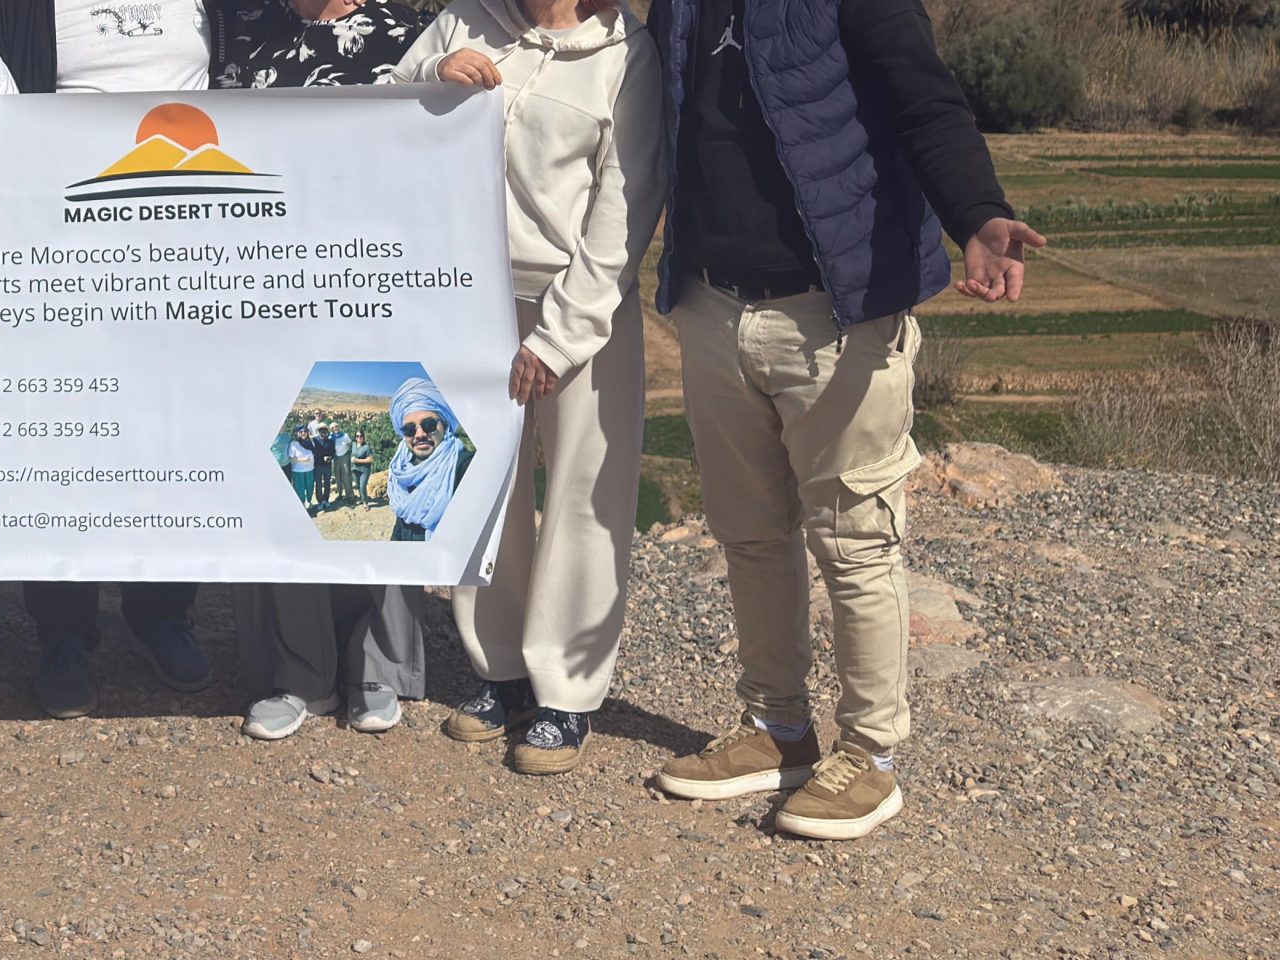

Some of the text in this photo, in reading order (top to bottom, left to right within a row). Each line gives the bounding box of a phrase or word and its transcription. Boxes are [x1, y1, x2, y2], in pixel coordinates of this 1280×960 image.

[63, 200, 288, 224] MAGIC DESERT TOURS
[149, 242, 230, 268] beauty,
[236, 239, 308, 261] where
[314, 237, 404, 260] endless
[28, 274, 86, 294] meet
[90, 271, 172, 293] vibrant
[177, 269, 256, 292] culture
[262, 267, 305, 290] and
[312, 266, 473, 295] unforgettable
[42, 301, 104, 328] begin
[109, 300, 158, 322] with
[165, 299, 233, 326] Magic
[240, 299, 319, 320] Desert
[323, 298, 393, 319] Tours
[17, 377, 48, 394] 663
[52, 377, 84, 393] 359
[87, 377, 120, 393] 453
[17, 421, 49, 438] 663
[52, 421, 85, 438] 359
[88, 421, 121, 438] 453
